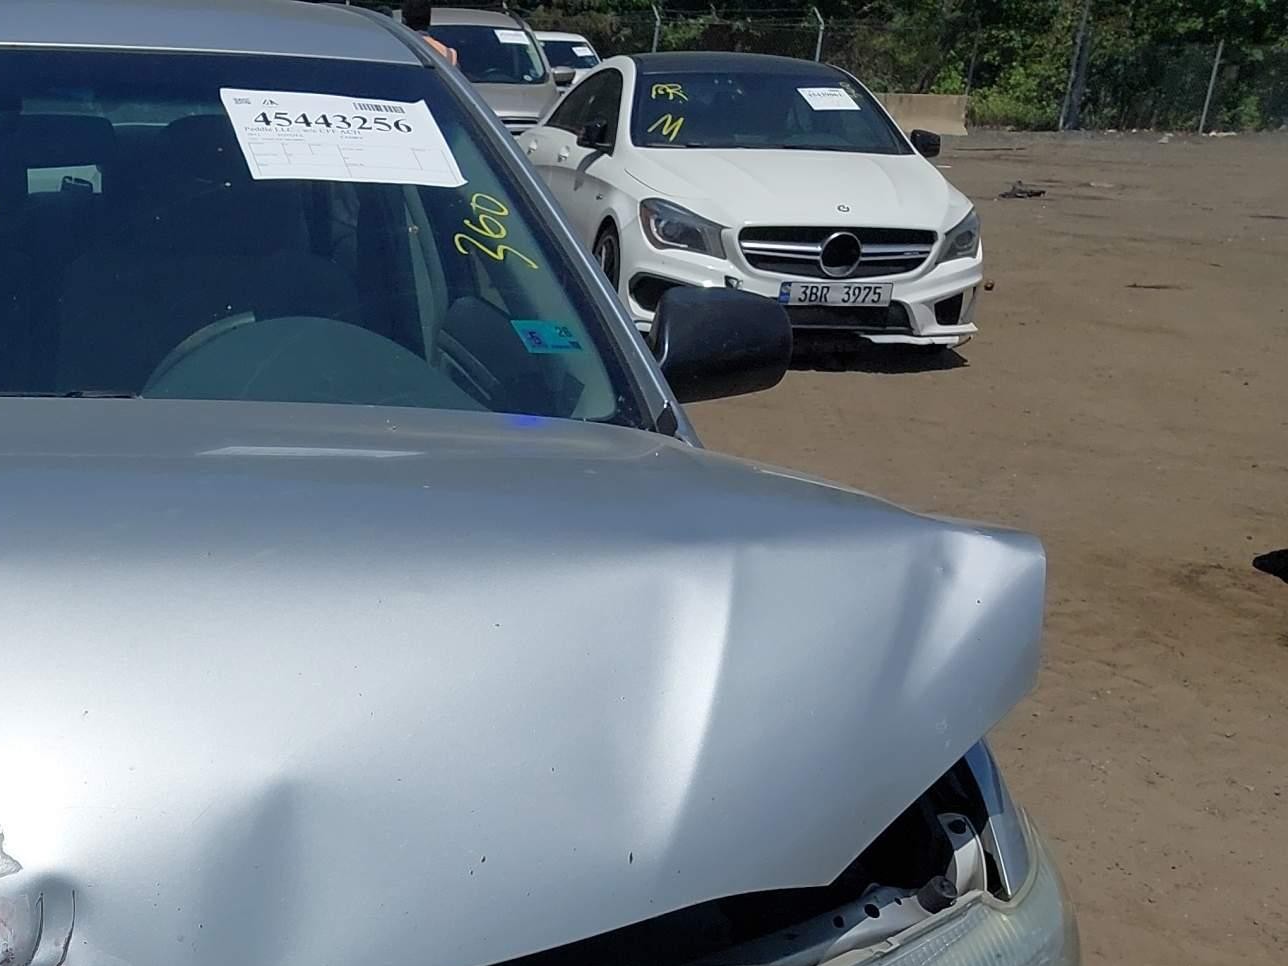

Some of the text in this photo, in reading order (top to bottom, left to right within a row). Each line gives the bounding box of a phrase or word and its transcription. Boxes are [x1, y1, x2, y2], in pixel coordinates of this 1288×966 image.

[253, 111, 413, 134] 45443256
[647, 113, 685, 142] M
[798, 285, 883, 304] 3BR 3975
